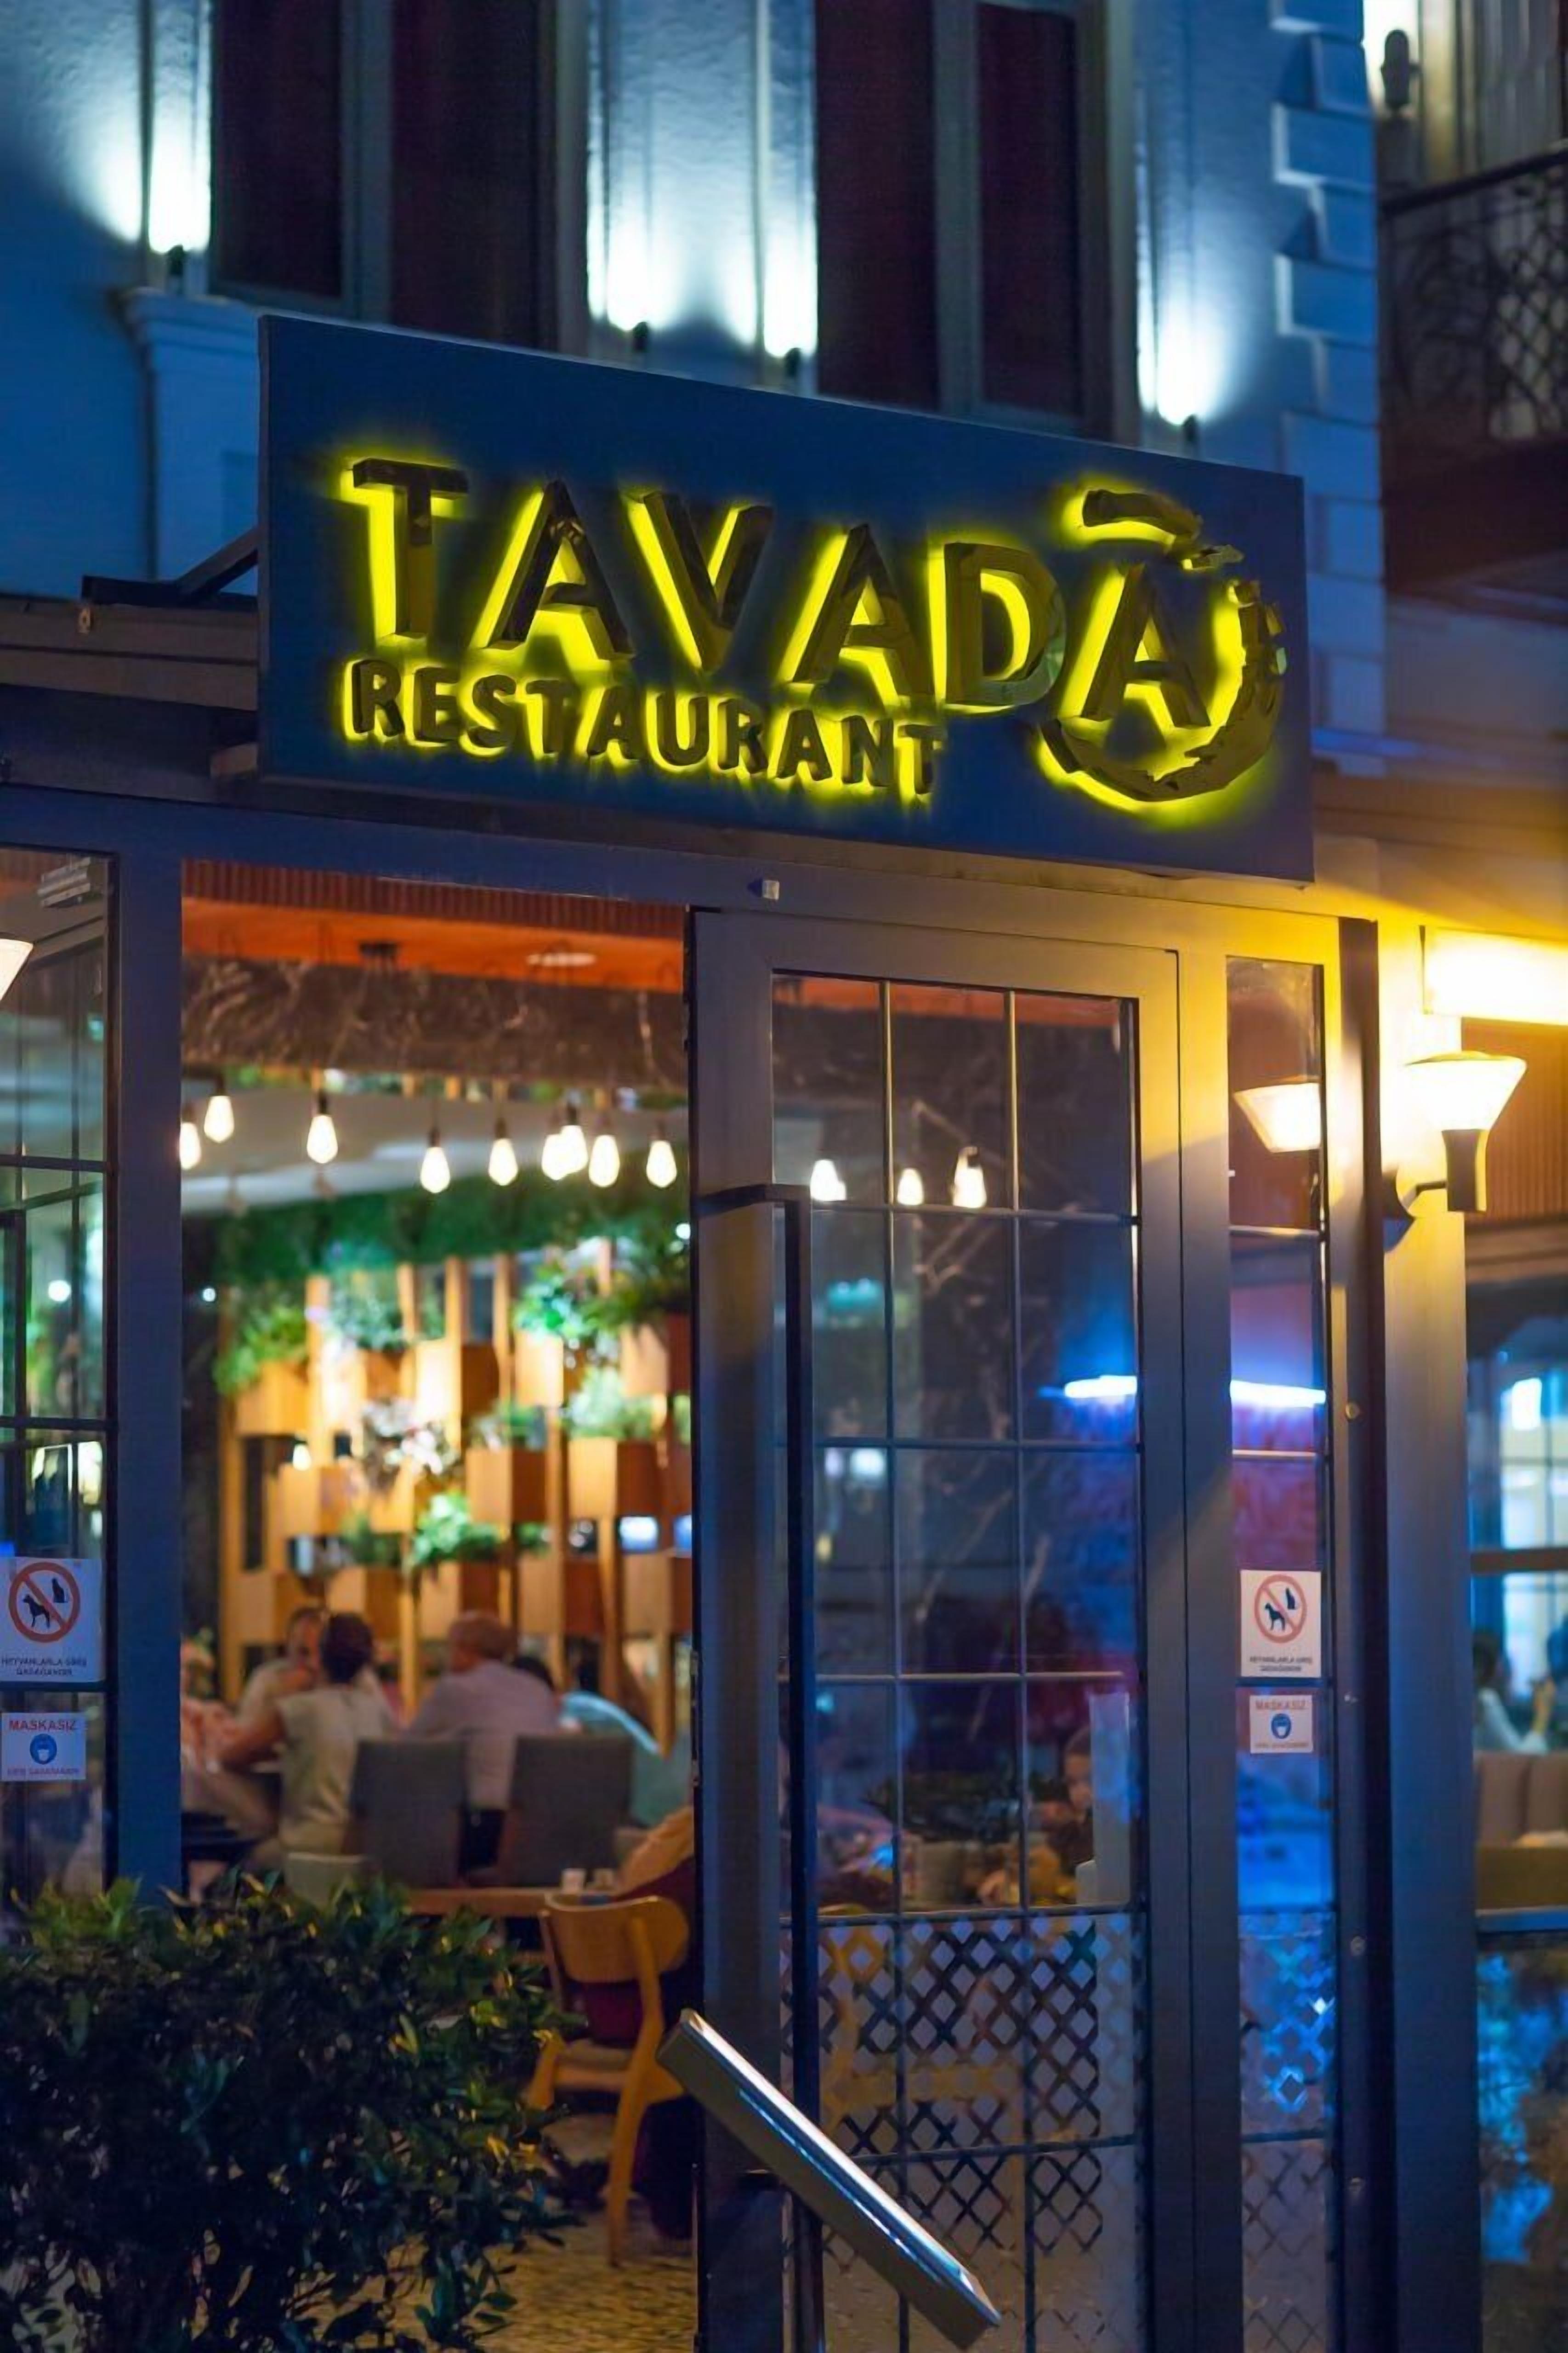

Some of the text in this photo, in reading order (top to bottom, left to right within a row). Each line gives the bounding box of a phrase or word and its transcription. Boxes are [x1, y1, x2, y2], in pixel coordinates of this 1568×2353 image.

[346, 458, 1211, 728] TAVADA
[347, 659, 947, 796] RESTAURANT
[9, 1720, 78, 1731] MASKASIZ
